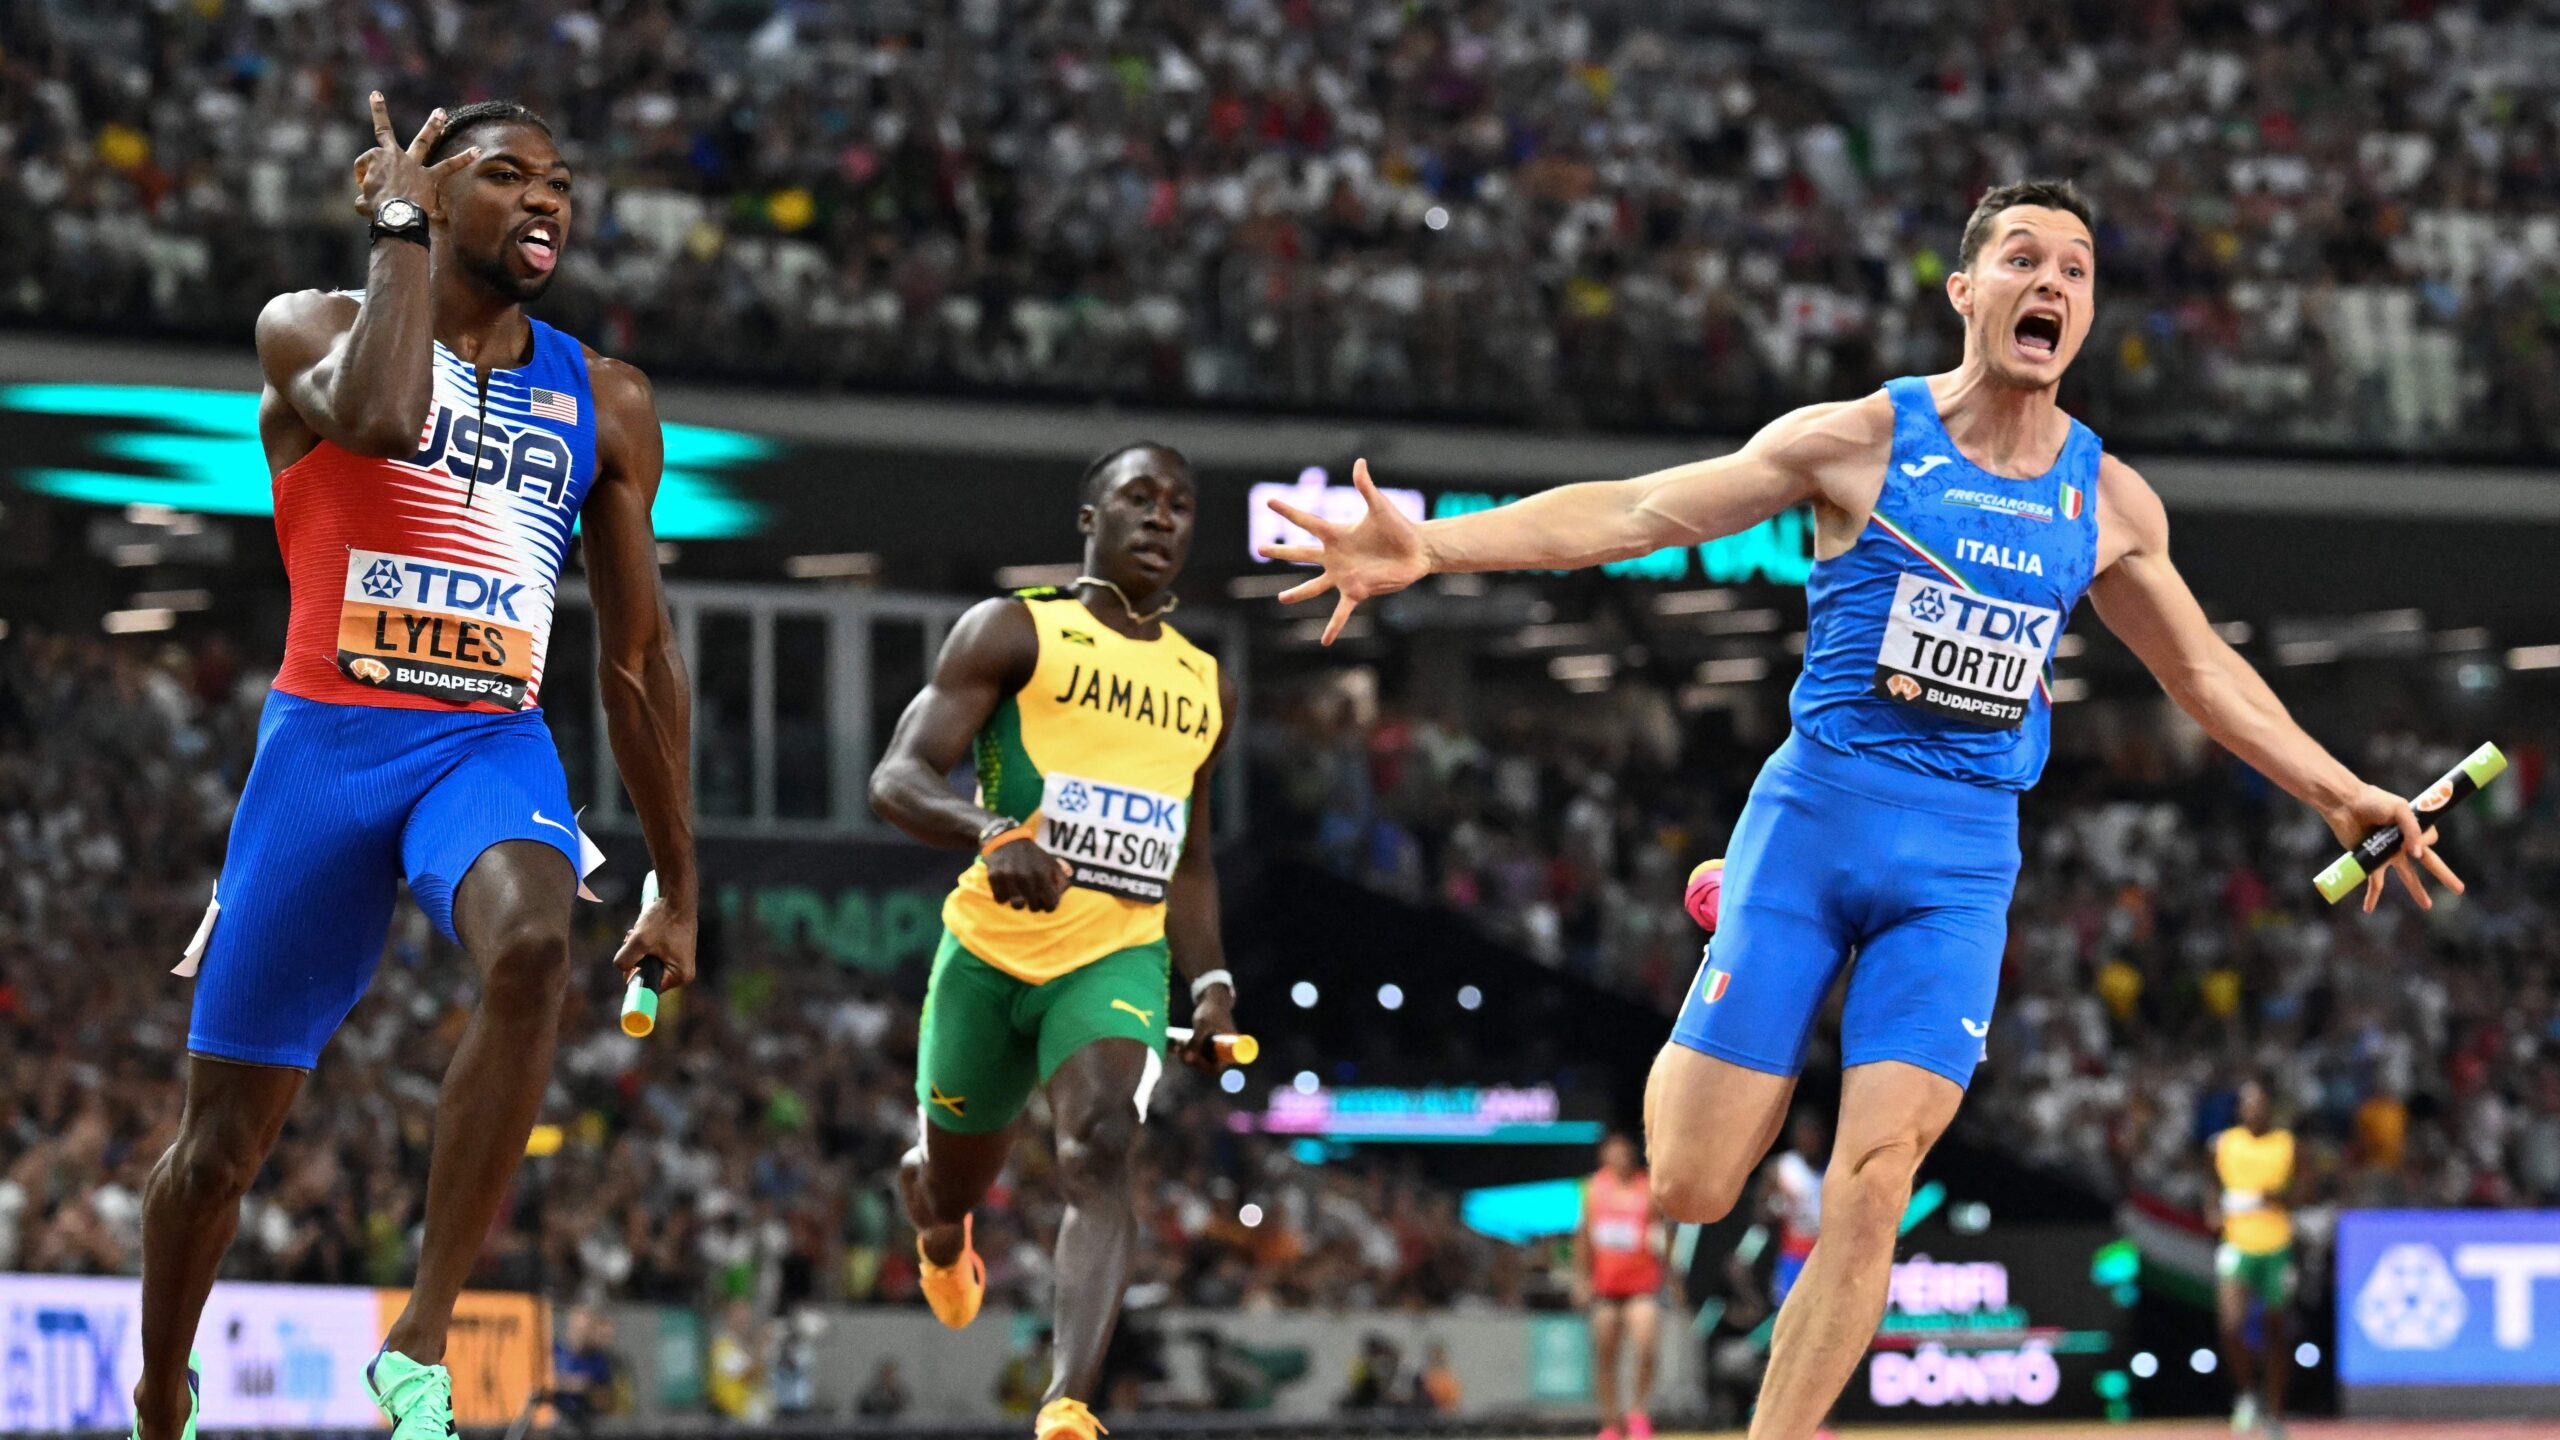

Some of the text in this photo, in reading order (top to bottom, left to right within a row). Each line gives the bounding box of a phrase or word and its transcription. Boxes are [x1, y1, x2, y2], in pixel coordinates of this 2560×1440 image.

[1944, 489, 2053, 517] FRECCIAROSSA
[1955, 538, 2043, 577] ITALIA
[404, 562, 525, 622] TDK
[375, 611, 507, 666] LYLES
[1949, 595, 2050, 648] TDK
[1910, 631, 2027, 693] TORTU
[1056, 665, 1209, 742] JAMAICA
[1092, 785, 1177, 833] TDK
[1049, 818, 1173, 873] WATSON
